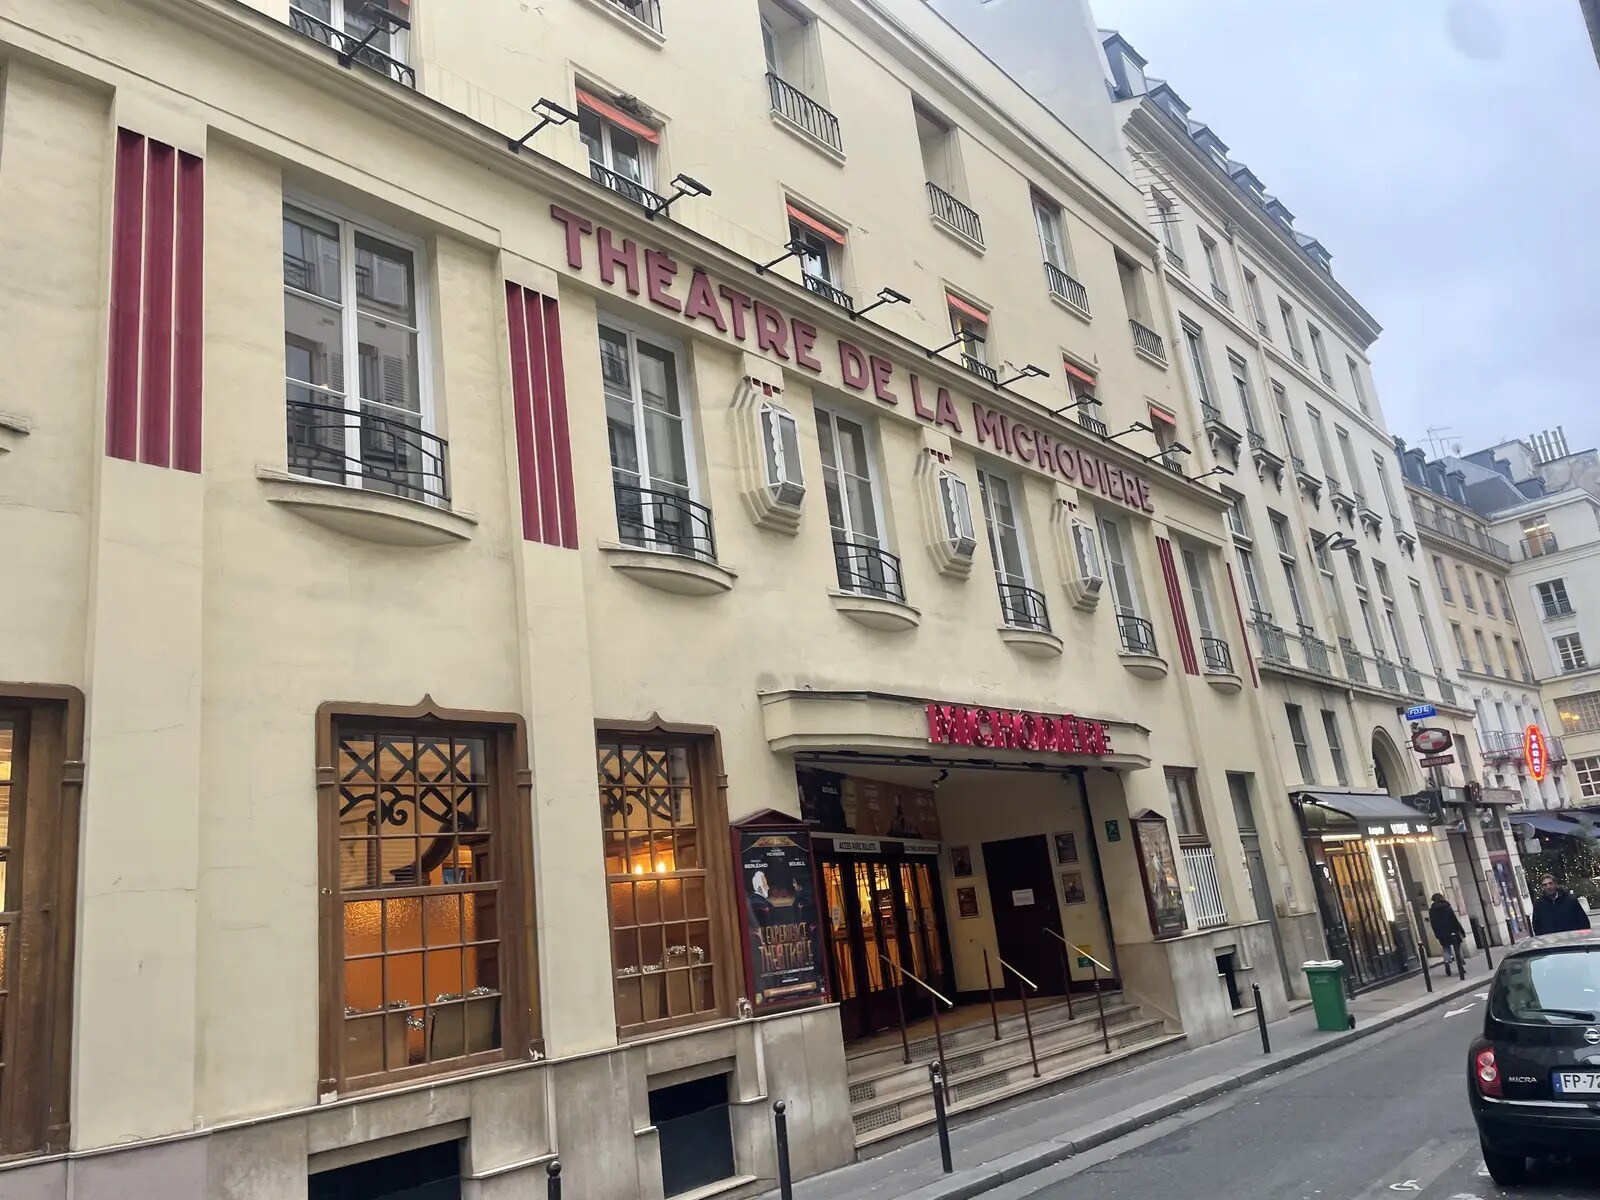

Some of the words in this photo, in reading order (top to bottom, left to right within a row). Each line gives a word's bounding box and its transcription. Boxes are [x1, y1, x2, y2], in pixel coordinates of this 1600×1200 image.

[838, 339, 898, 405] DE
[910, 373, 963, 434] LA
[1530, 734, 1541, 773] TABAC
